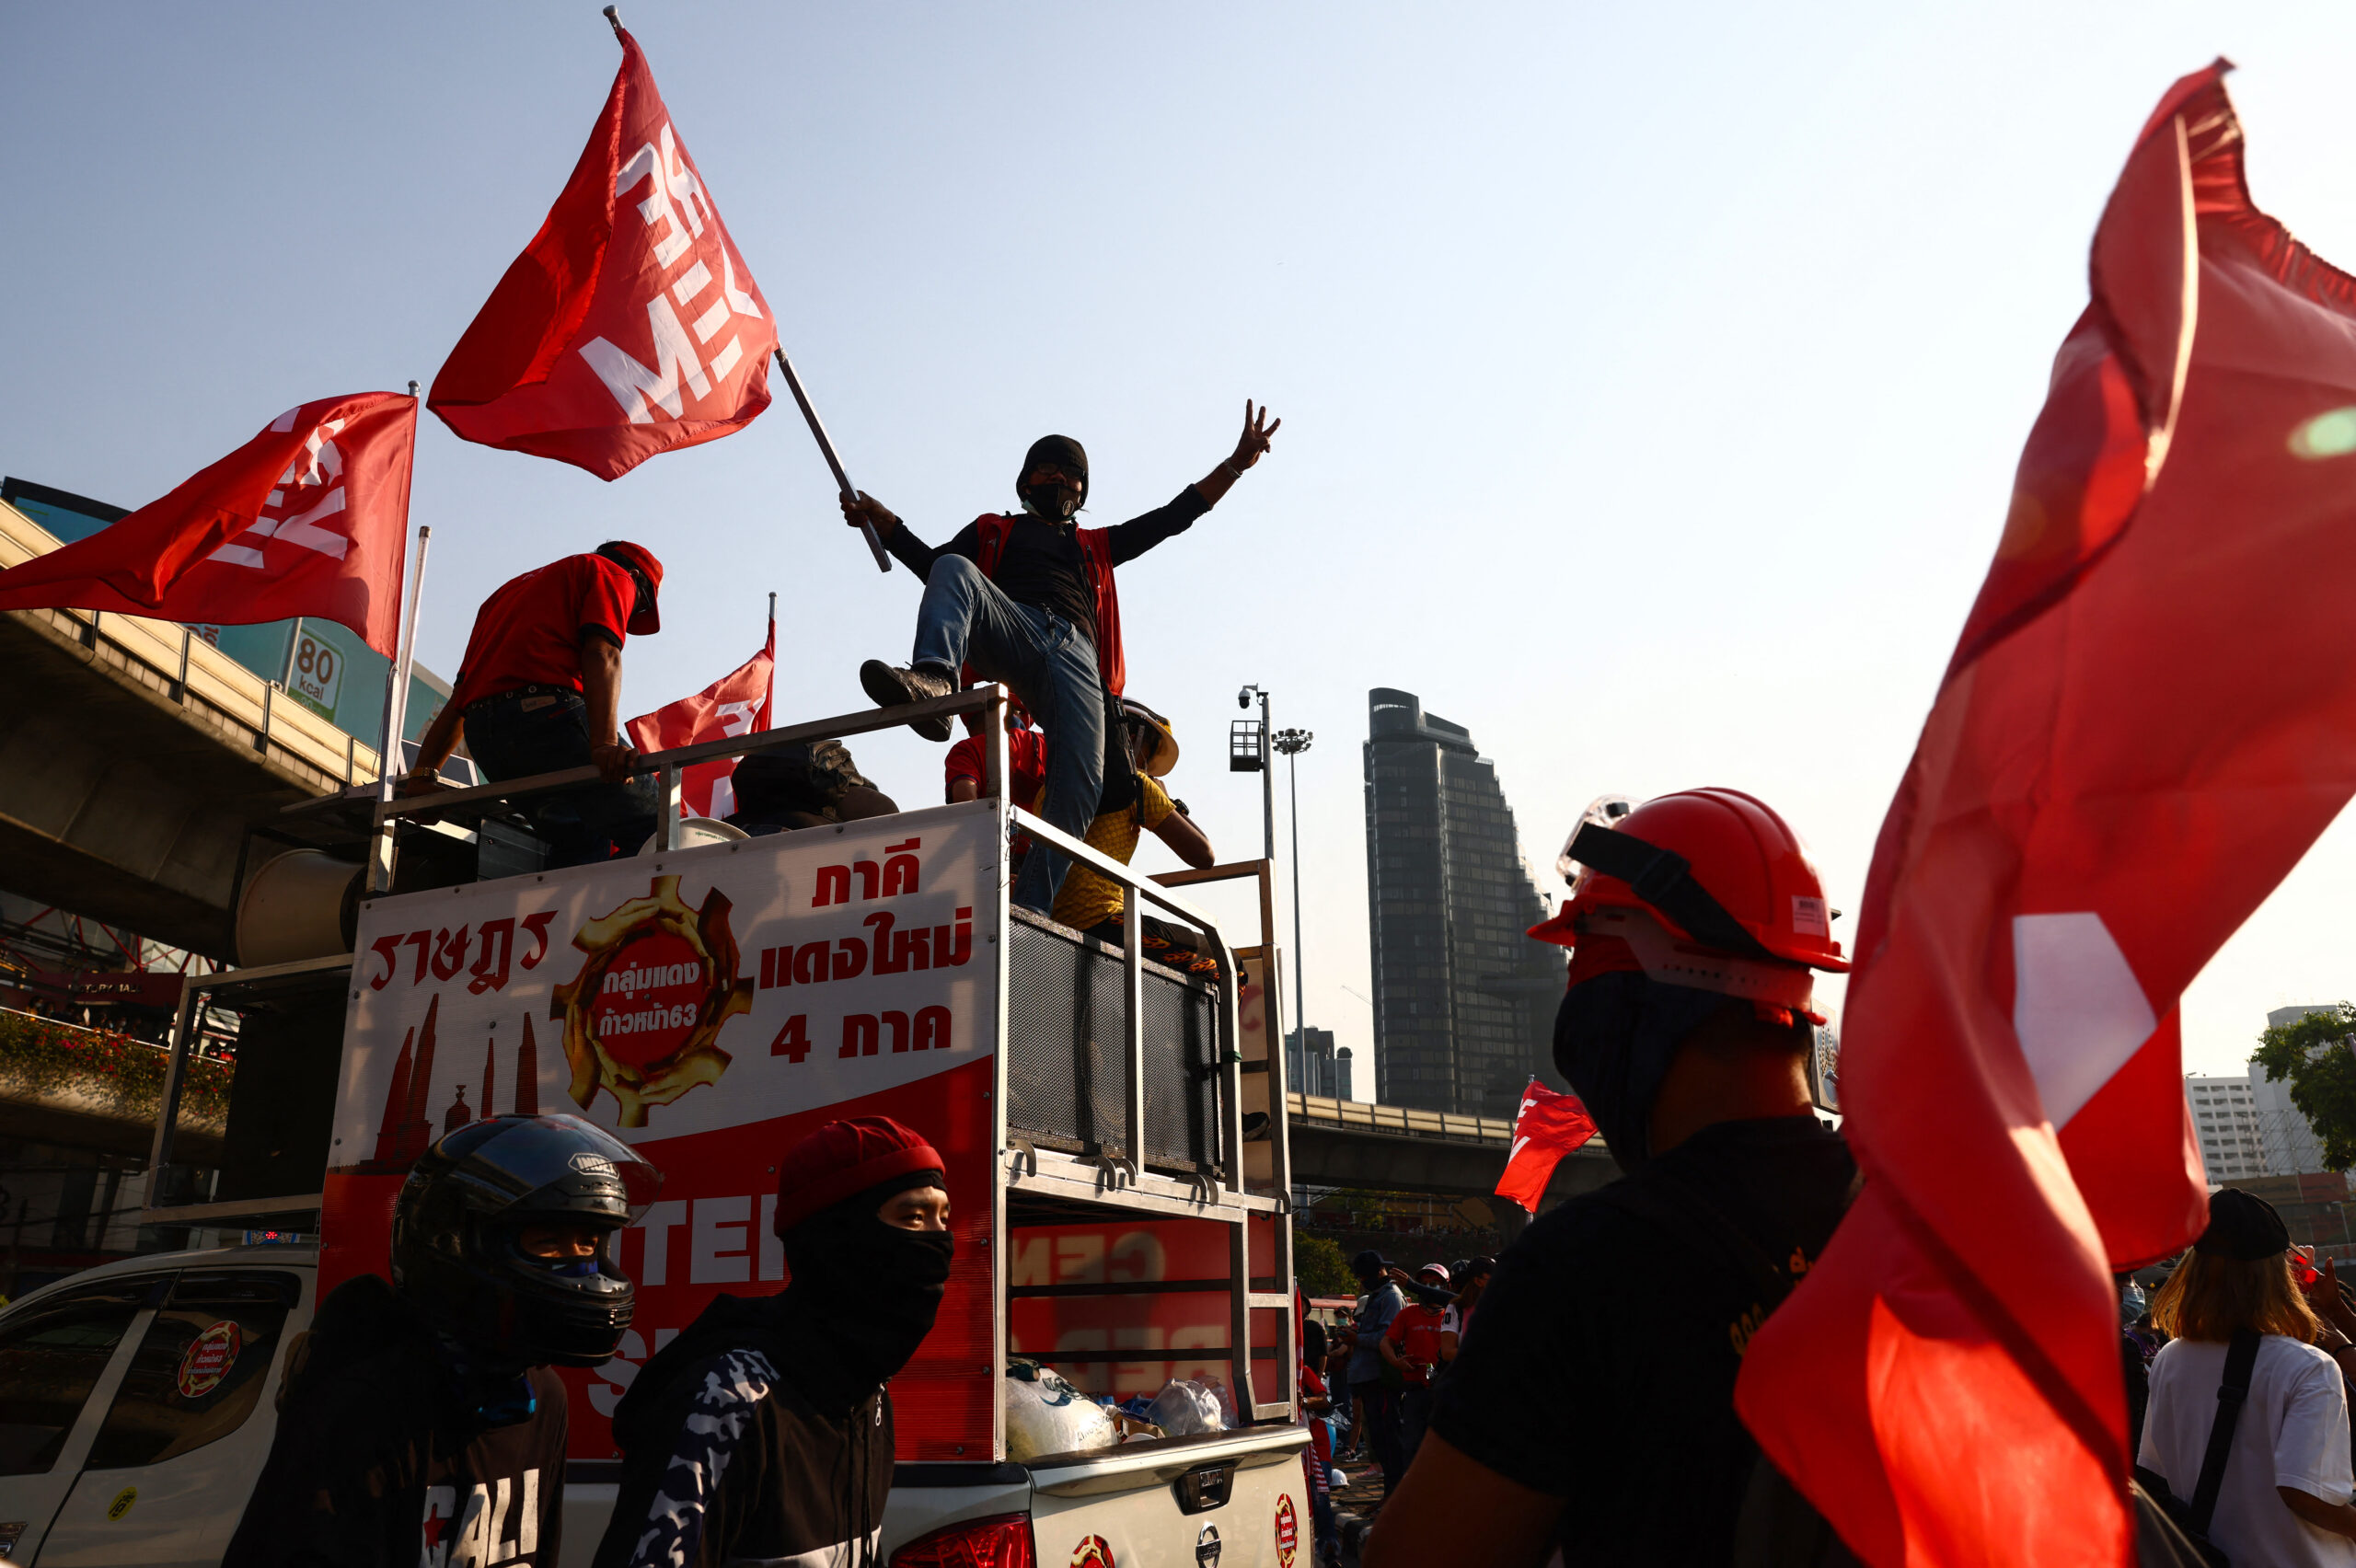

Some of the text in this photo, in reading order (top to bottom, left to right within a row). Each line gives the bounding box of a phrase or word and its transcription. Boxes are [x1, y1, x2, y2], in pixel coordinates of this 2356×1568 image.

[297, 638, 334, 685] 80
[298, 674, 325, 701] kcal
[812, 836, 921, 908] ภาคี
[758, 905, 973, 990] แดงใหม่
[603, 961, 700, 1000] กลุ่มแดง
[598, 1002, 699, 1037] ก้าวหน้า63
[770, 1005, 952, 1064] 4 ภาค
[575, 1157, 618, 1175] INDEX
